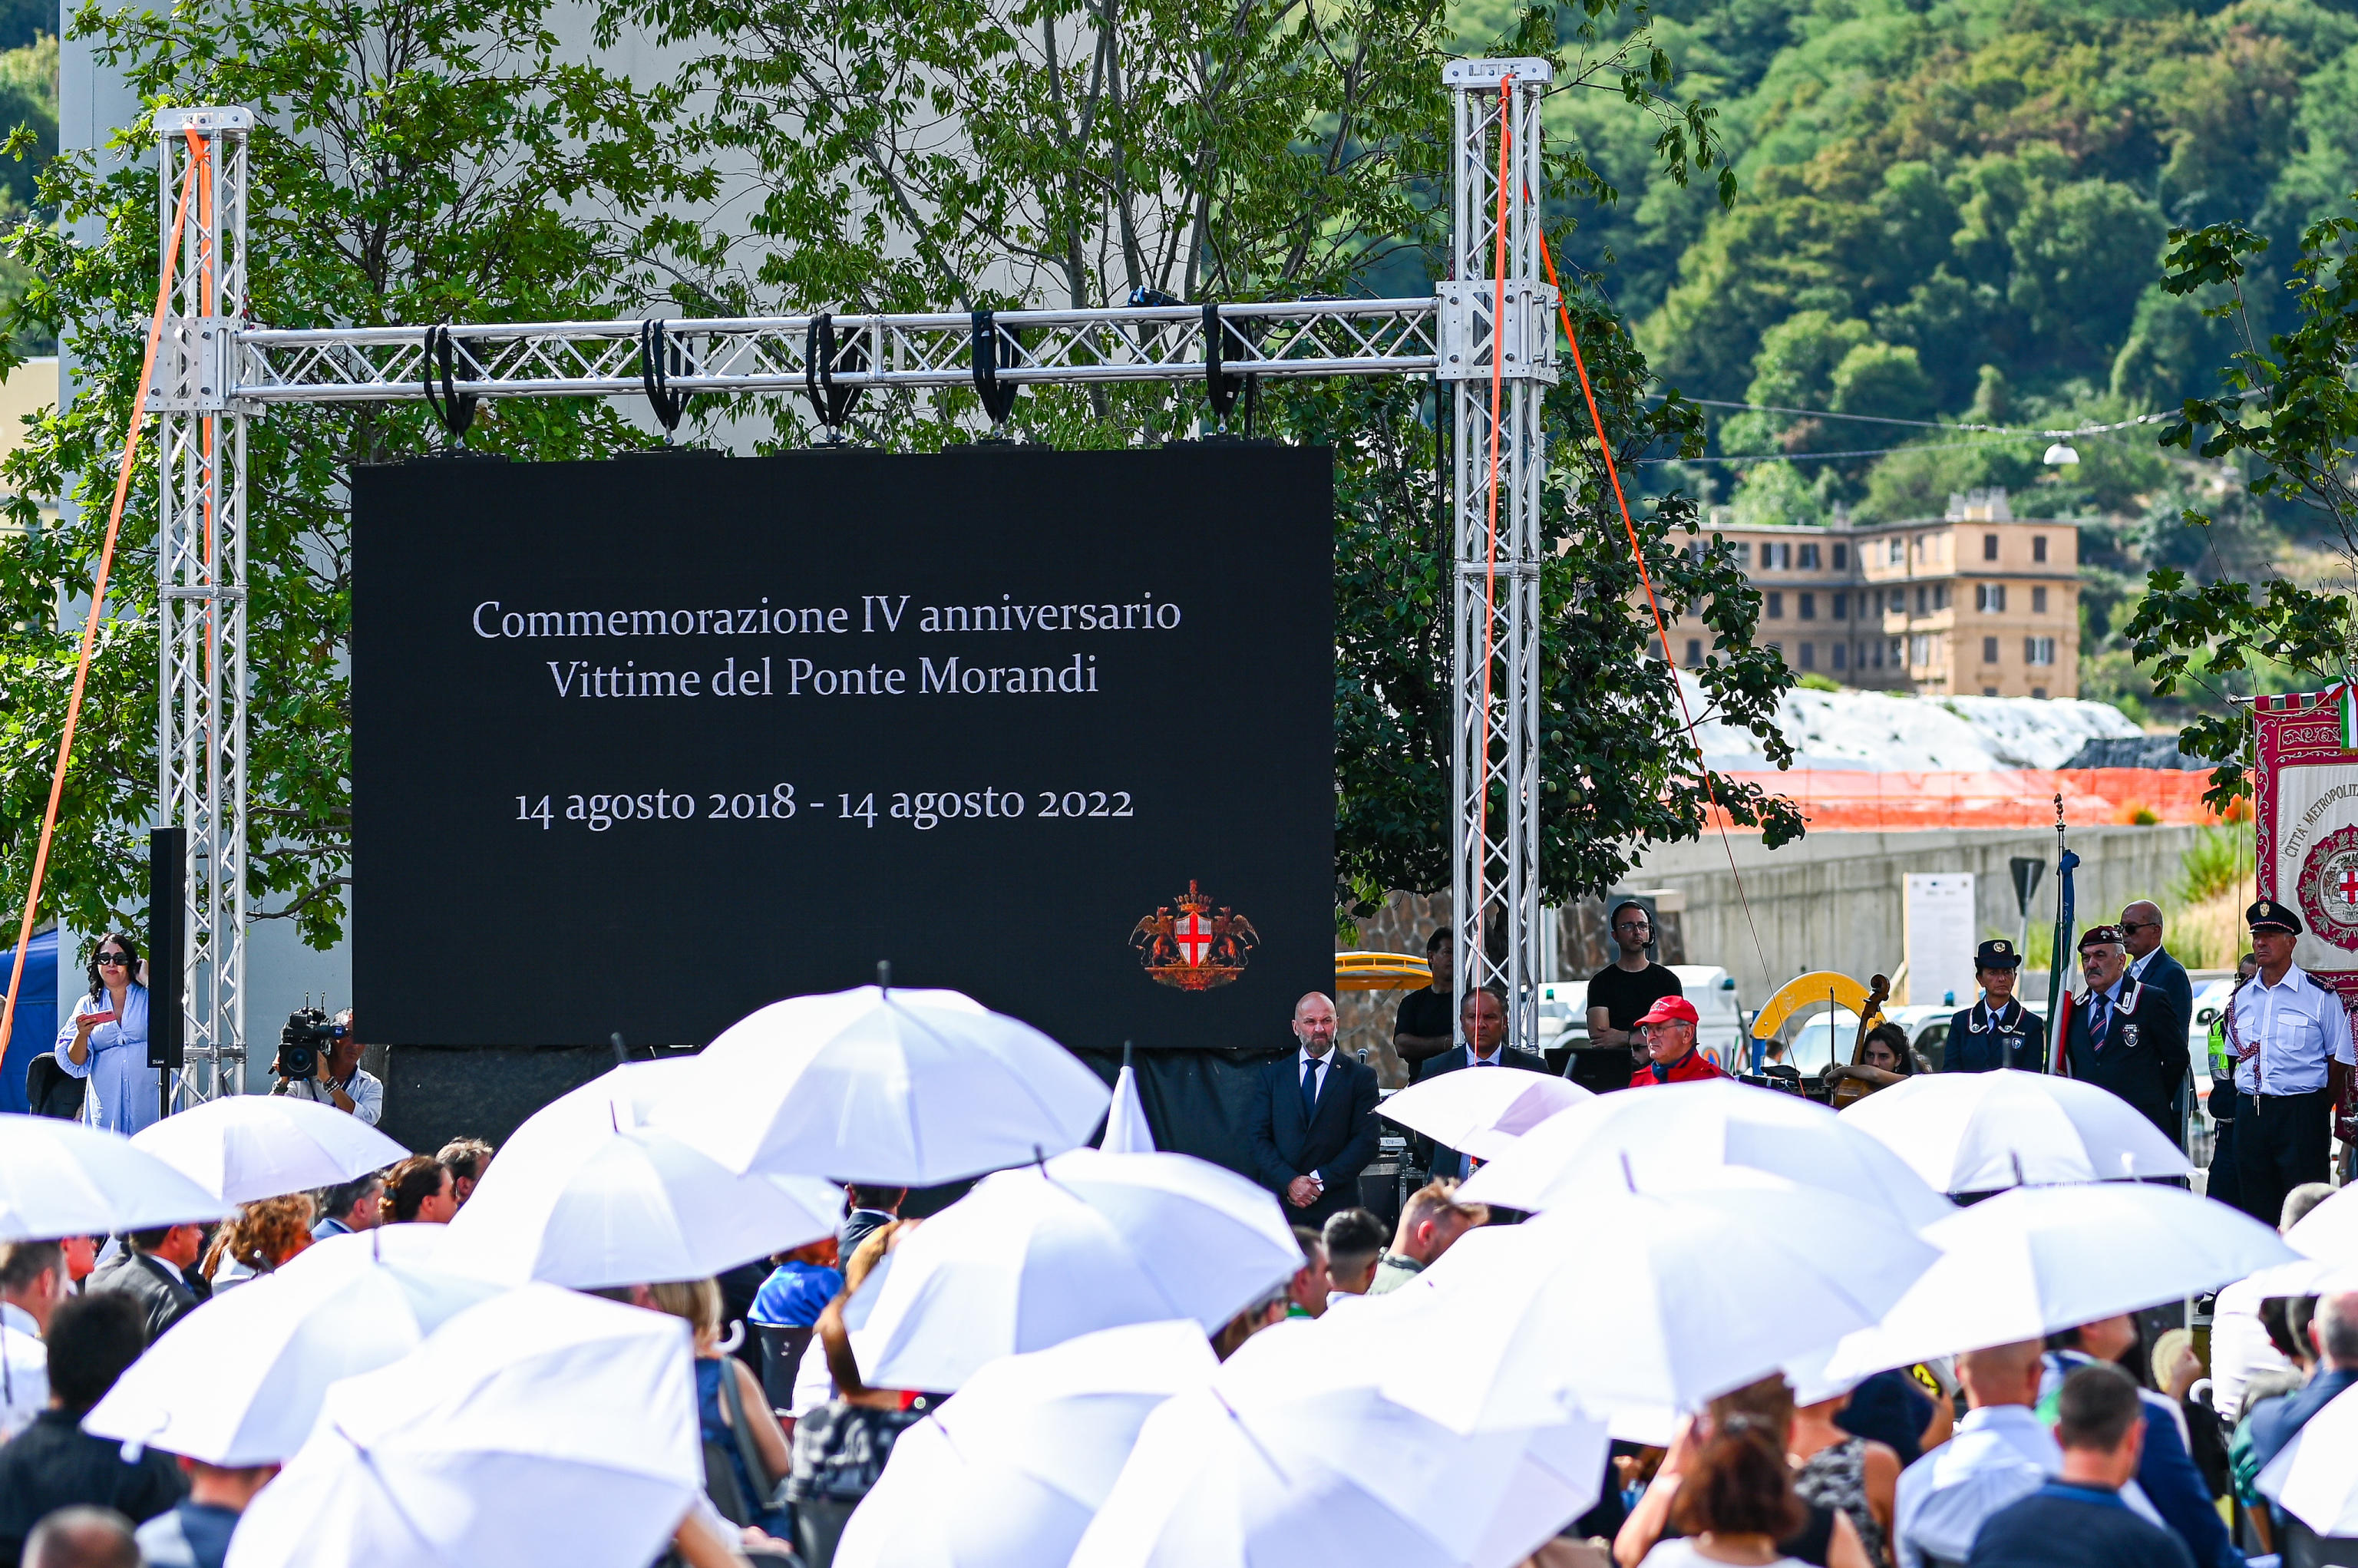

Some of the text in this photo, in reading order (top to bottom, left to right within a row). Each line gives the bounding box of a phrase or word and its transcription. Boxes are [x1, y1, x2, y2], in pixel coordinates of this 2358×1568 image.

[473, 592, 1181, 639] Commemorazione IV anniversario
[546, 652, 1099, 698] Vittime del Ponte Morandi
[515, 794, 555, 830] 14
[566, 788, 695, 832] agosto
[708, 782, 796, 819] 2018
[837, 792, 878, 829] 14
[890, 786, 1025, 830] agosto
[1038, 791, 1134, 817] 2022
[2303, 784, 2358, 826] METROPOLIT
